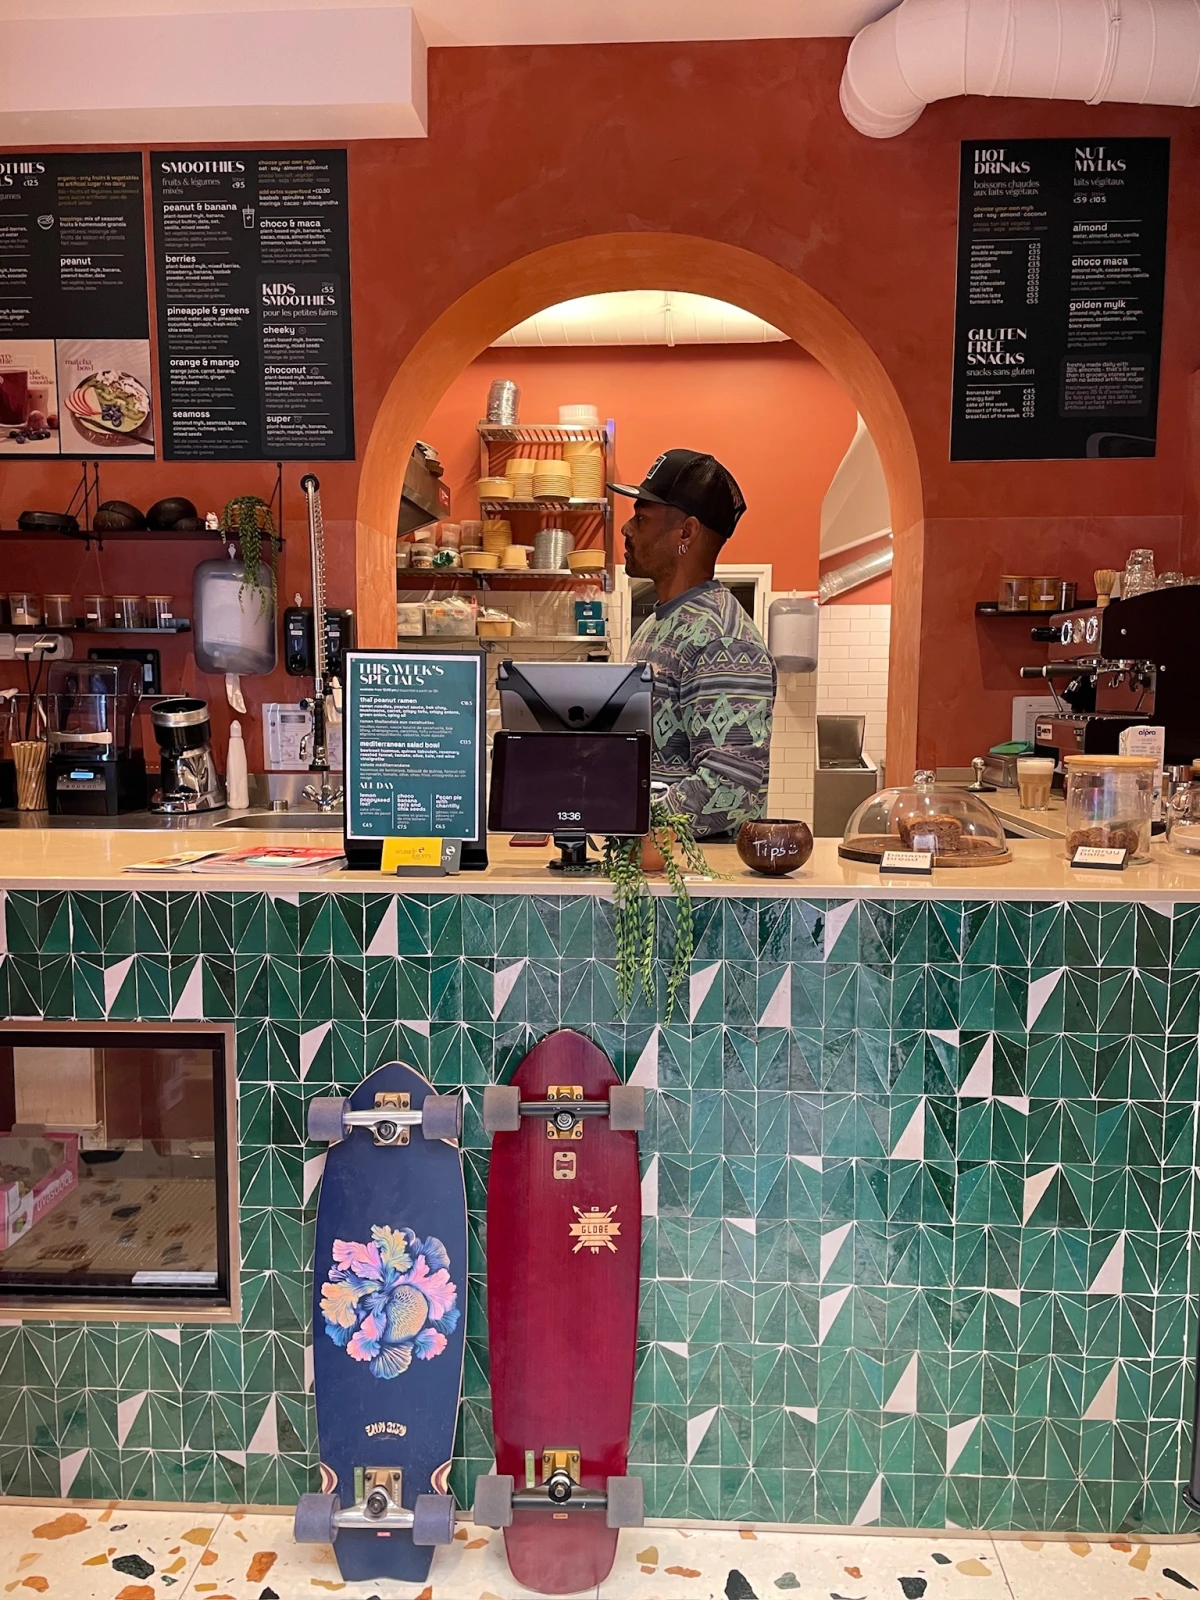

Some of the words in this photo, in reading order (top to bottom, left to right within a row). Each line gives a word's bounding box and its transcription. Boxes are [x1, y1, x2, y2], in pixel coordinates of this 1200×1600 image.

[975, 149, 1007, 161] HOT
[1075, 147, 1106, 159] NUT
[162, 162, 244, 173] SMOOTHIES
[974, 161, 1030, 174] DRINKS
[1075, 160, 1126, 171] MYLKS
[191, 178, 220, 187] légumes
[974, 180, 1006, 189] boissons
[1008, 180, 1039, 188] chaudes
[1091, 177, 1124, 187] végétaux
[1005, 188, 1038, 197] végétaux
[164, 204, 194, 213] peanut
[1073, 223, 1107, 231] almond
[61, 257, 91, 266] peanut
[1072, 258, 1100, 266] choco
[262, 284, 295, 295] KIDS
[262, 296, 335, 306] SMOOTHIES
[1070, 301, 1101, 310] golden
[1104, 300, 1125, 310] mylk
[168, 307, 210, 316] pineapple
[220, 308, 249, 316] greens
[263, 309, 280, 318] pour
[293, 309, 317, 318] petites
[264, 326, 295, 335] cheeky
[968, 328, 1027, 340] GLUTEN
[968, 341, 1004, 352] FREE
[210, 359, 239, 367] mango
[967, 353, 1024, 365] SNACKS
[1011, 368, 1034, 377] gluten
[358, 664, 389, 674] THIS
[392, 664, 444, 675] WEEK'S
[360, 674, 424, 686] SPECIALS
[557, 812, 580, 820] 13:36
[753, 840, 785, 860] Tips
